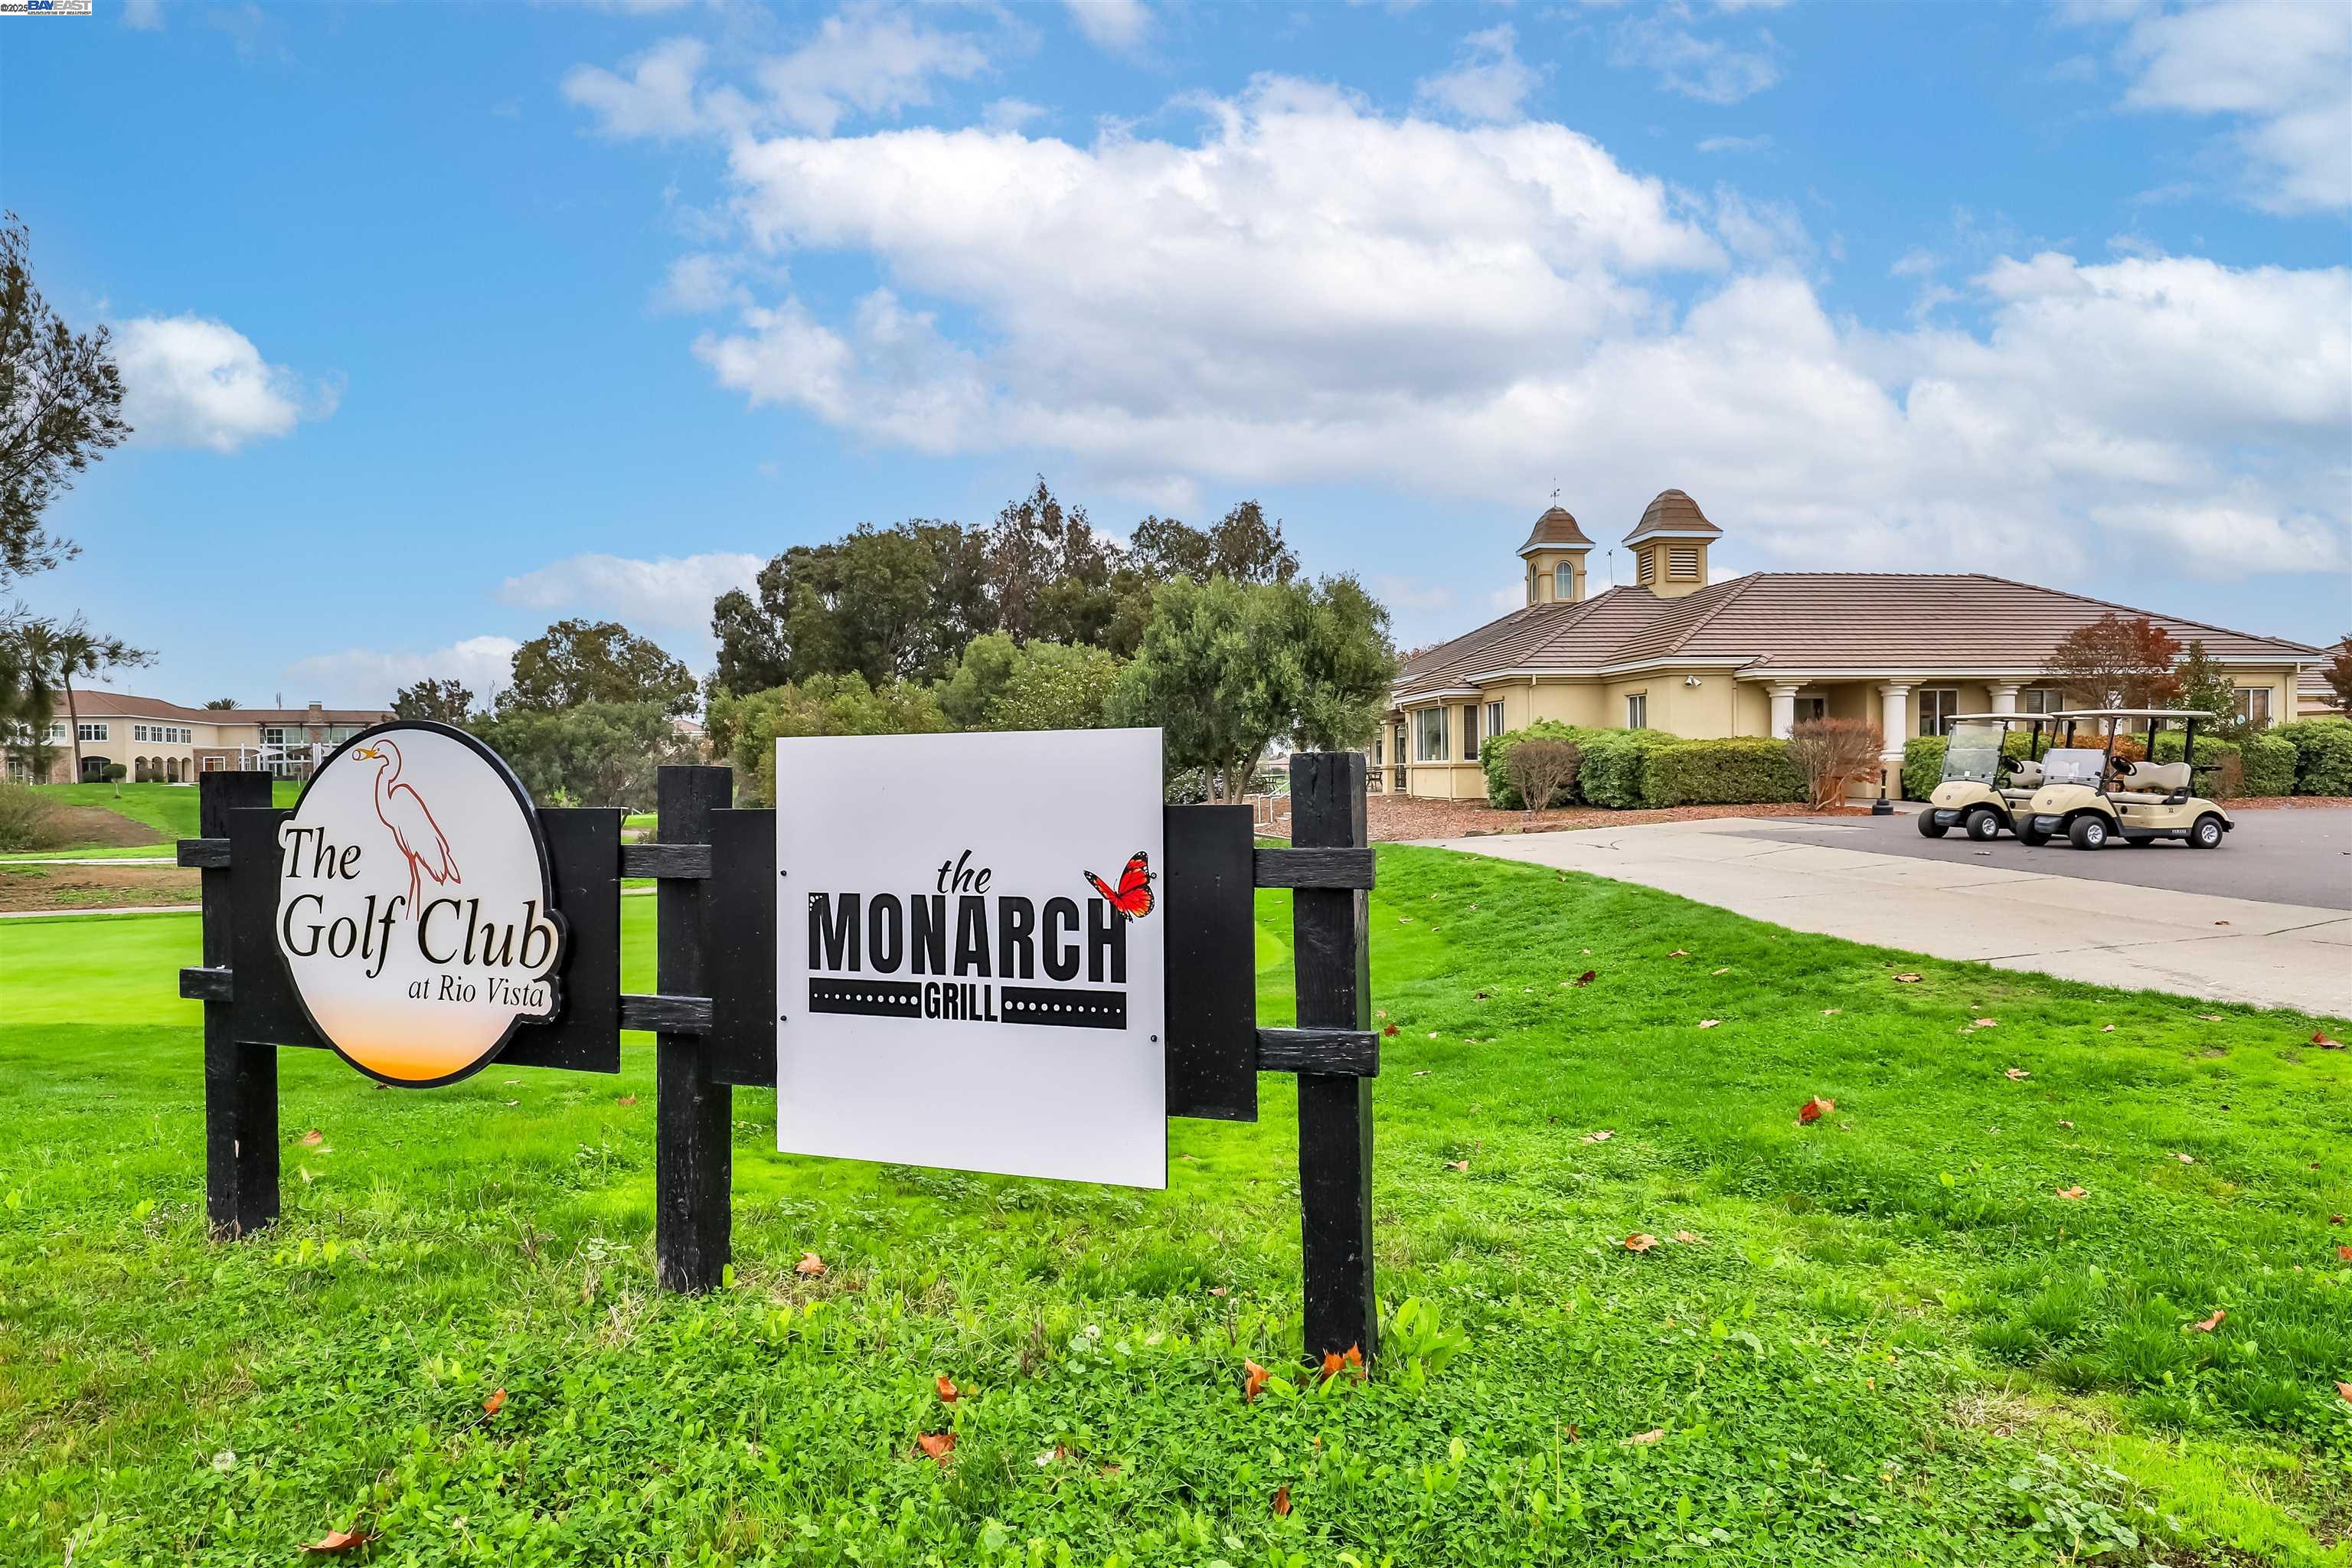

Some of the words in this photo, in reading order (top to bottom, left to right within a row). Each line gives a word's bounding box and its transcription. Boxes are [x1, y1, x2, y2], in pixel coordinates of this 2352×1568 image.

[285, 827, 361, 880] The
[937, 849, 991, 894] the
[283, 894, 406, 978] Golf
[417, 898, 552, 969] Club
[808, 892, 1127, 983] MONARCH
[408, 978, 429, 999] at
[437, 975, 476, 1003] Rio
[488, 977, 544, 1008] Vista
[924, 982, 998, 1022] GRILL
